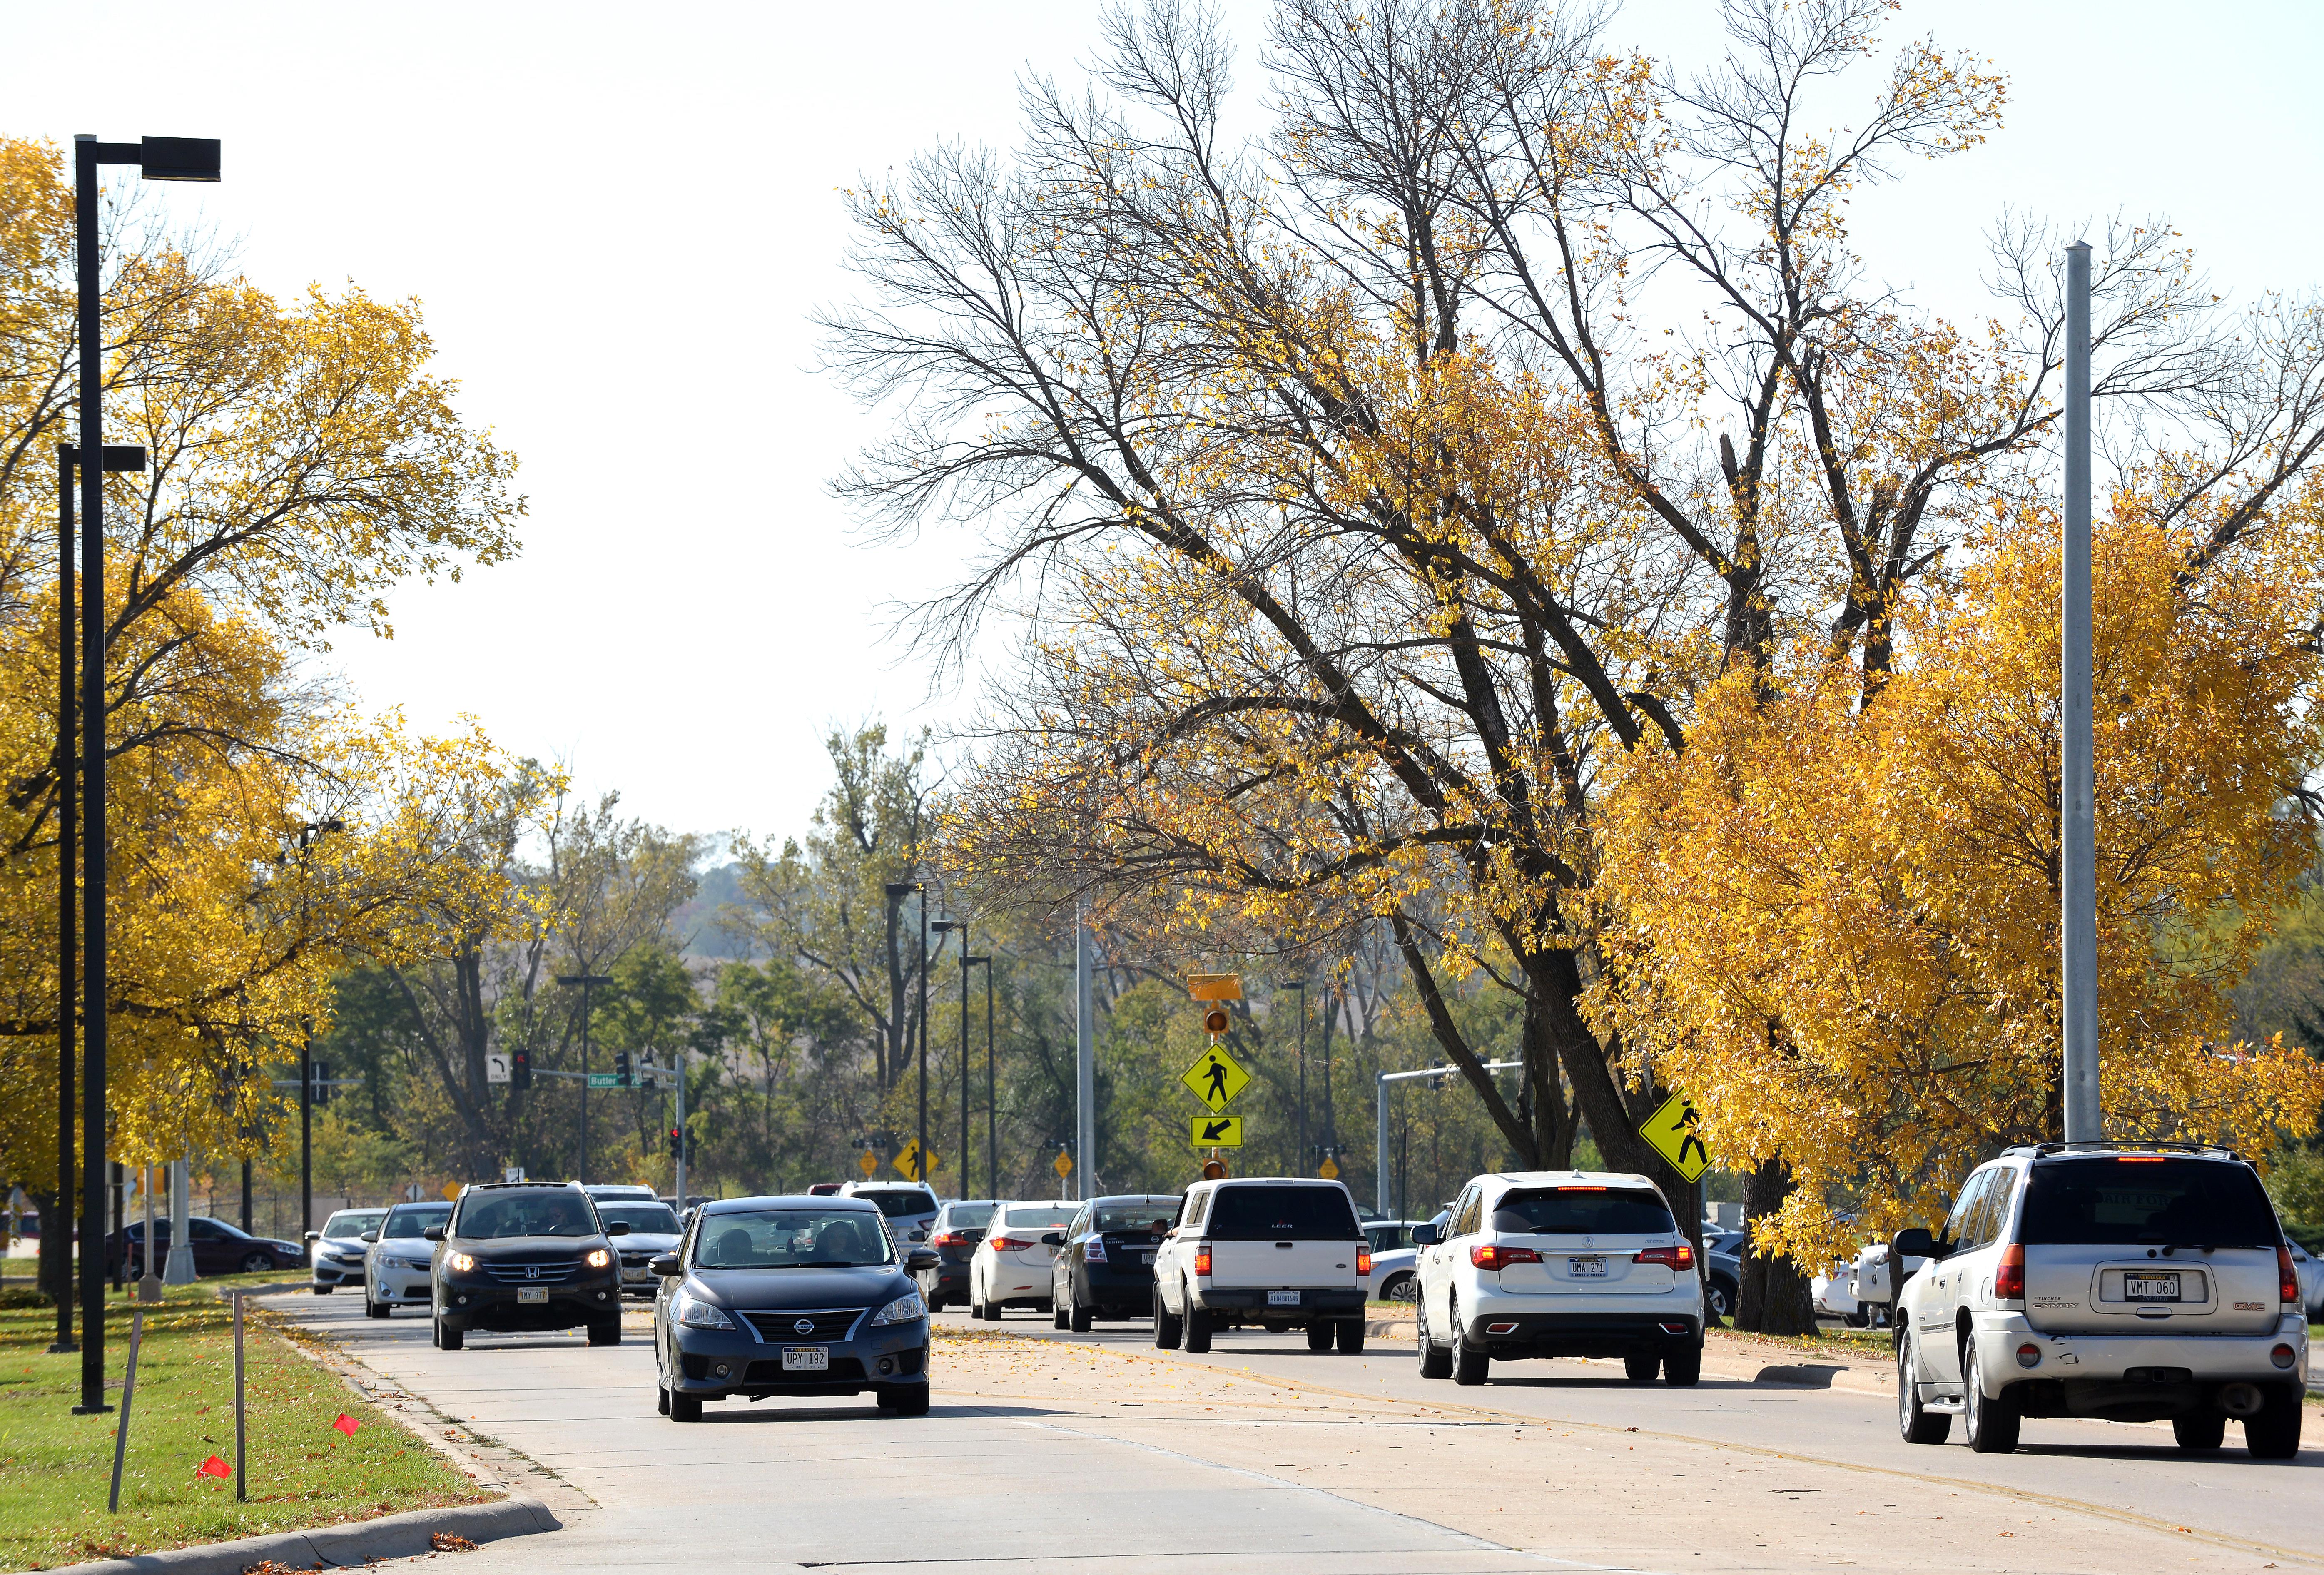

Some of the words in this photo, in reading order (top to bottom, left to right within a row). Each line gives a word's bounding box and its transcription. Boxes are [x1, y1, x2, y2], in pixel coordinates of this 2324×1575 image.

[591, 1077, 616, 1085] Butler
[1572, 1263, 1586, 1272] UMA
[1591, 1263, 1604, 1272] 271
[2131, 1281, 2149, 1294] VMT
[2156, 1281, 2175, 1294] 060
[2233, 1302, 2265, 1311] GMC
[787, 1353, 802, 1364] UPY
[809, 1353, 824, 1364] 192
